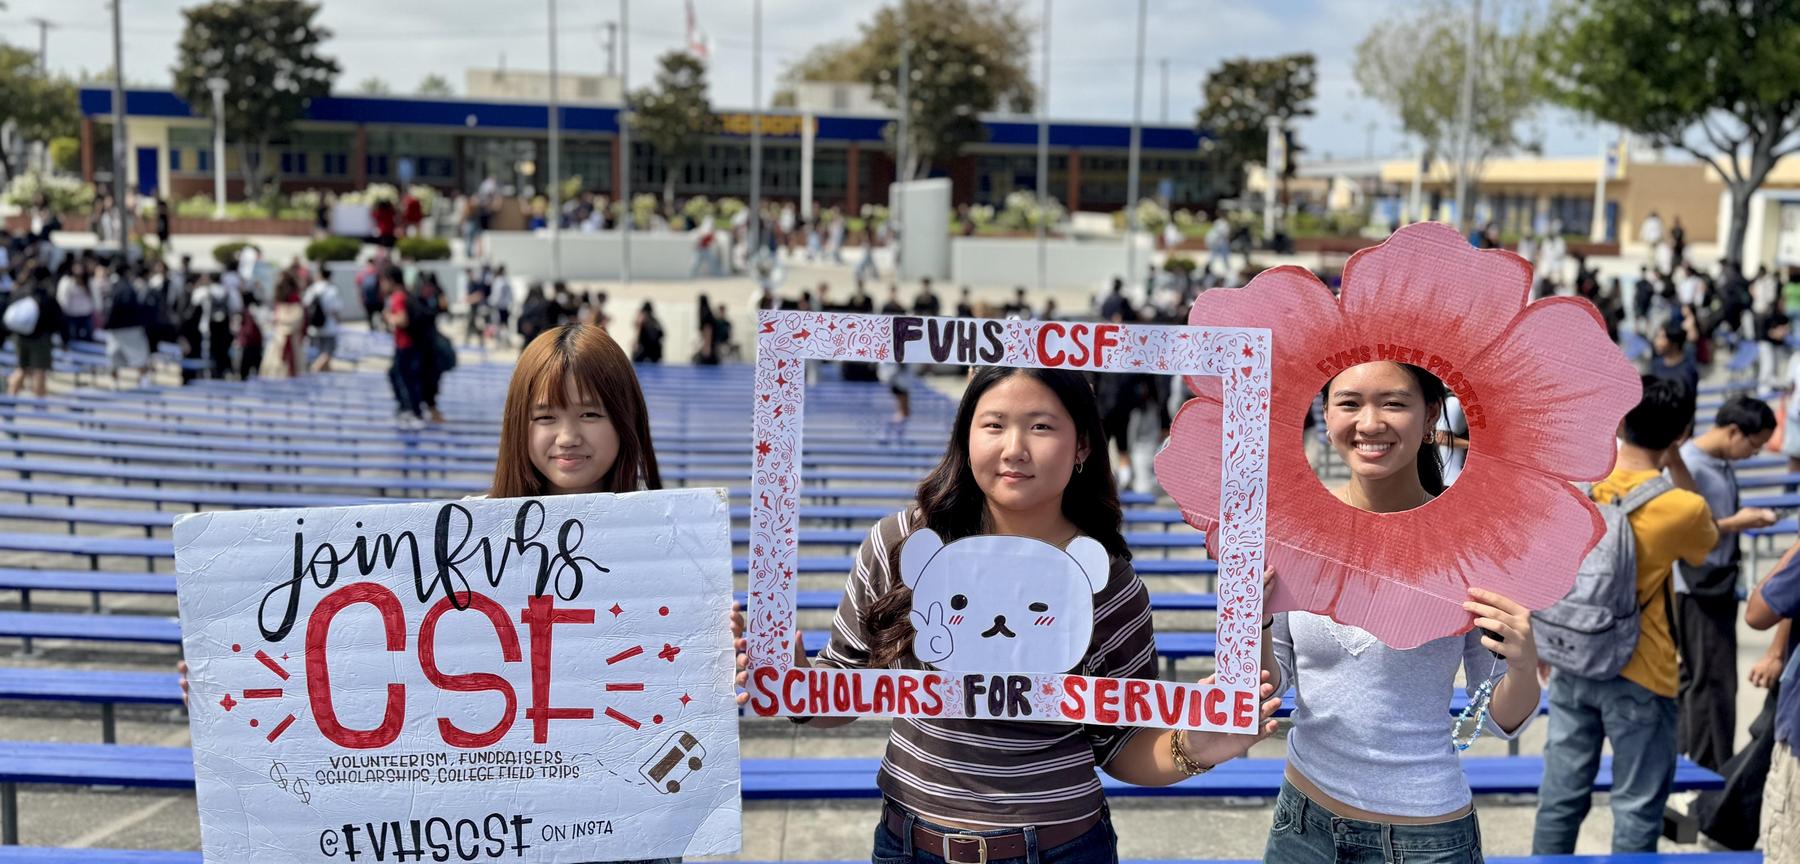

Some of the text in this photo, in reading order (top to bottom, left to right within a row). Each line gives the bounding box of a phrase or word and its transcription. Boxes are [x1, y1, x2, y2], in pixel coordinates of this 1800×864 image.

[892, 317, 1120, 367] FVHS CSF
[1315, 343, 1487, 430] FVHS HER PROJECT
[305, 582, 595, 749] CSF
[752, 666, 1255, 728] SCHOLARS FOR SERVICE
[438, 766, 496, 783] COLLEGE
[498, 764, 534, 780] FIELD
[541, 764, 580, 779] TRIPS
[459, 751, 563, 766] FUNDRAISERS
[541, 823, 567, 842] ON
[571, 820, 614, 839] INSTA
